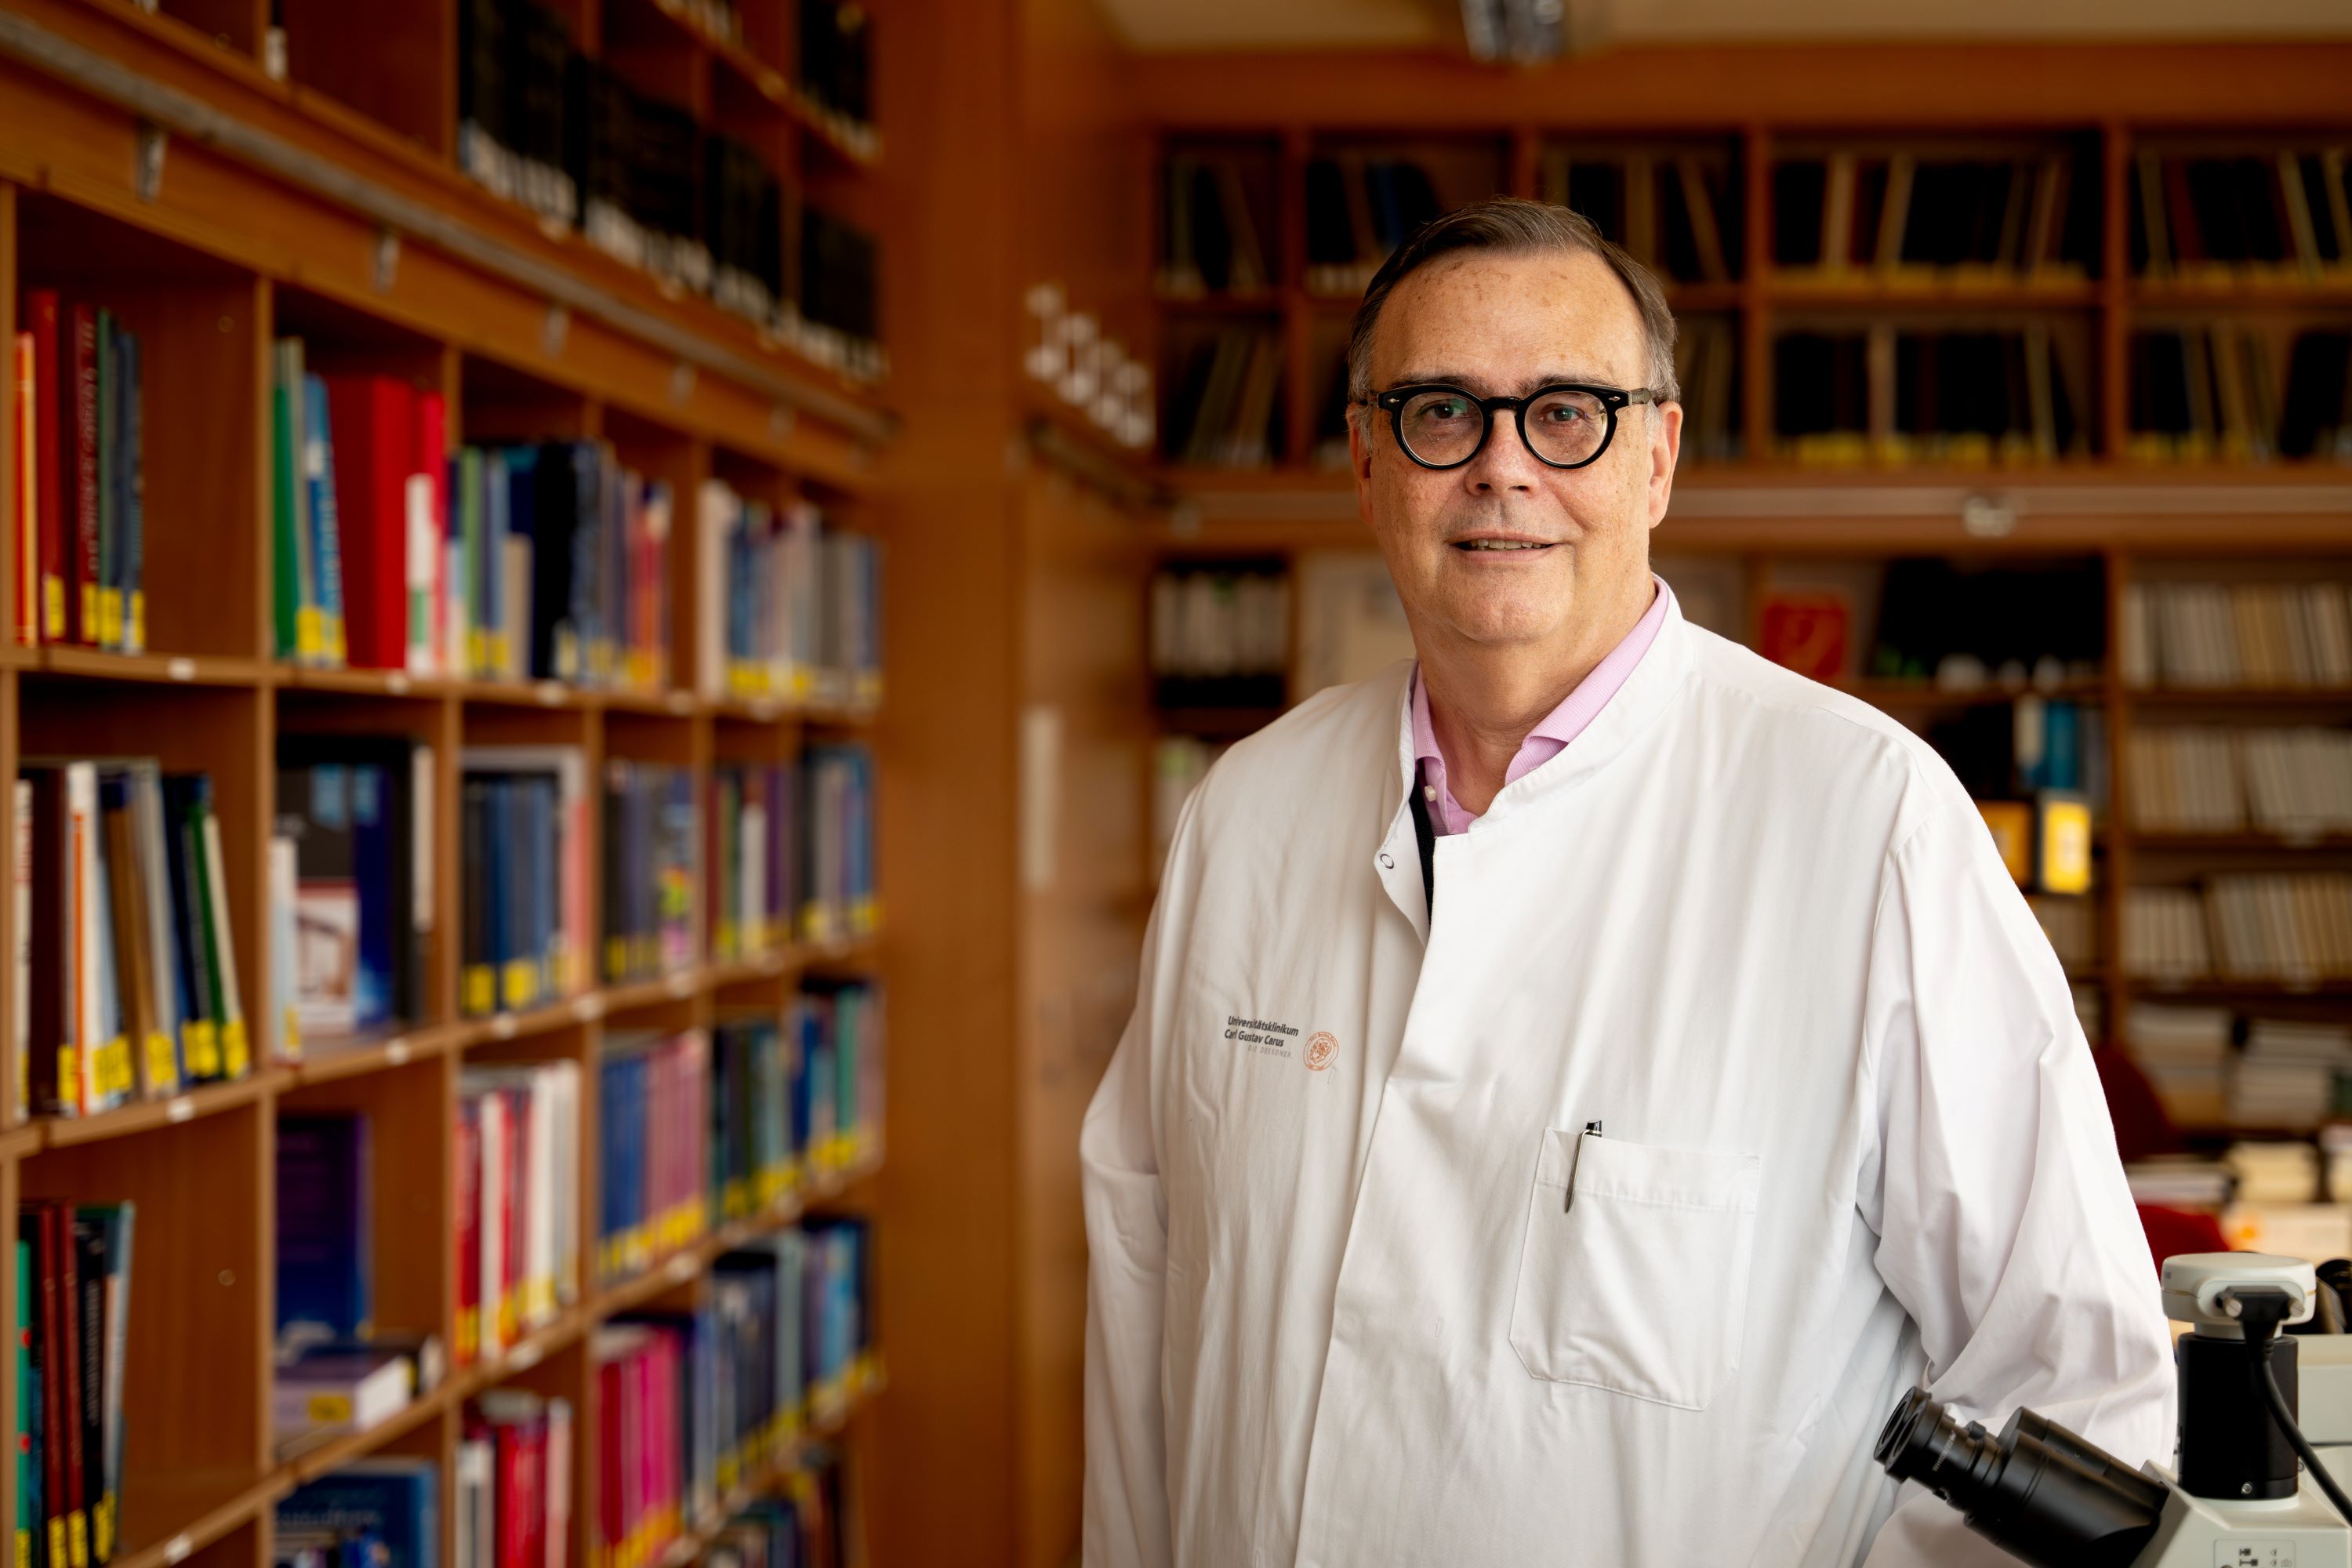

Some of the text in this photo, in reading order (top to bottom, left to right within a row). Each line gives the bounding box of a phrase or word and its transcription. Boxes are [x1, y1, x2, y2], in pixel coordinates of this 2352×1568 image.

[1228, 1016, 1299, 1036] Universitätsklinikum
[1225, 1029, 1284, 1047] Carl Gustav Carus
